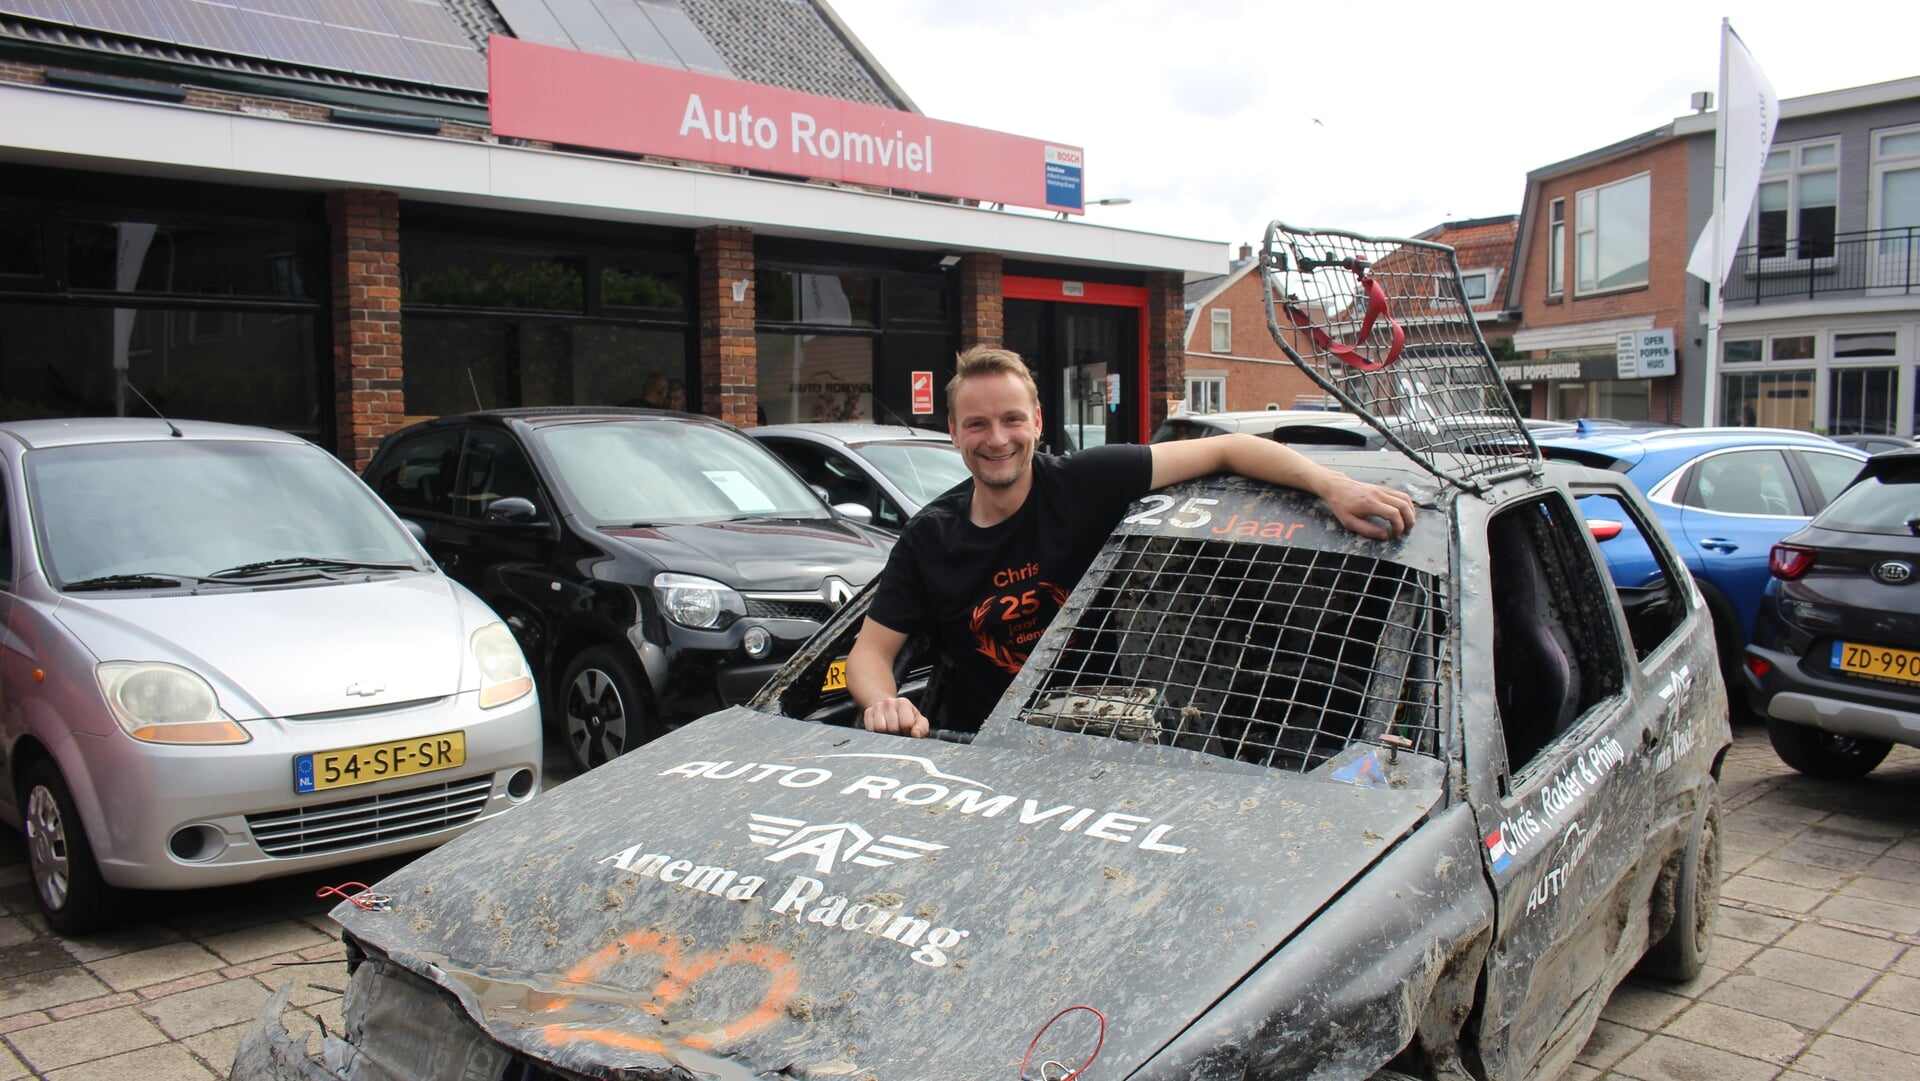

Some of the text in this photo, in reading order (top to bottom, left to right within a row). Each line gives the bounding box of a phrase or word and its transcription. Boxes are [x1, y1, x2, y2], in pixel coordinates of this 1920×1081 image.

[679, 93, 933, 173] Auto Romviel
[1057, 152, 1080, 163] BOSCH
[1640, 347, 1672, 358] POPPEN-
[1644, 336, 1664, 346] OPEN
[1499, 362, 1581, 381] OPEN POPPENHUIS
[1647, 359, 1664, 369] HUIS
[1123, 494, 1305, 540] 25 Jaar
[993, 562, 1040, 589] Chris
[1000, 589, 1040, 620] 25
[324, 739, 453, 783] 54-SF-SR
[299, 777, 313, 787] NL
[658, 760, 1189, 855] AUTO ROMVIEL
[1499, 805, 1541, 856] Chris
[598, 842, 970, 968] Anema Racing
